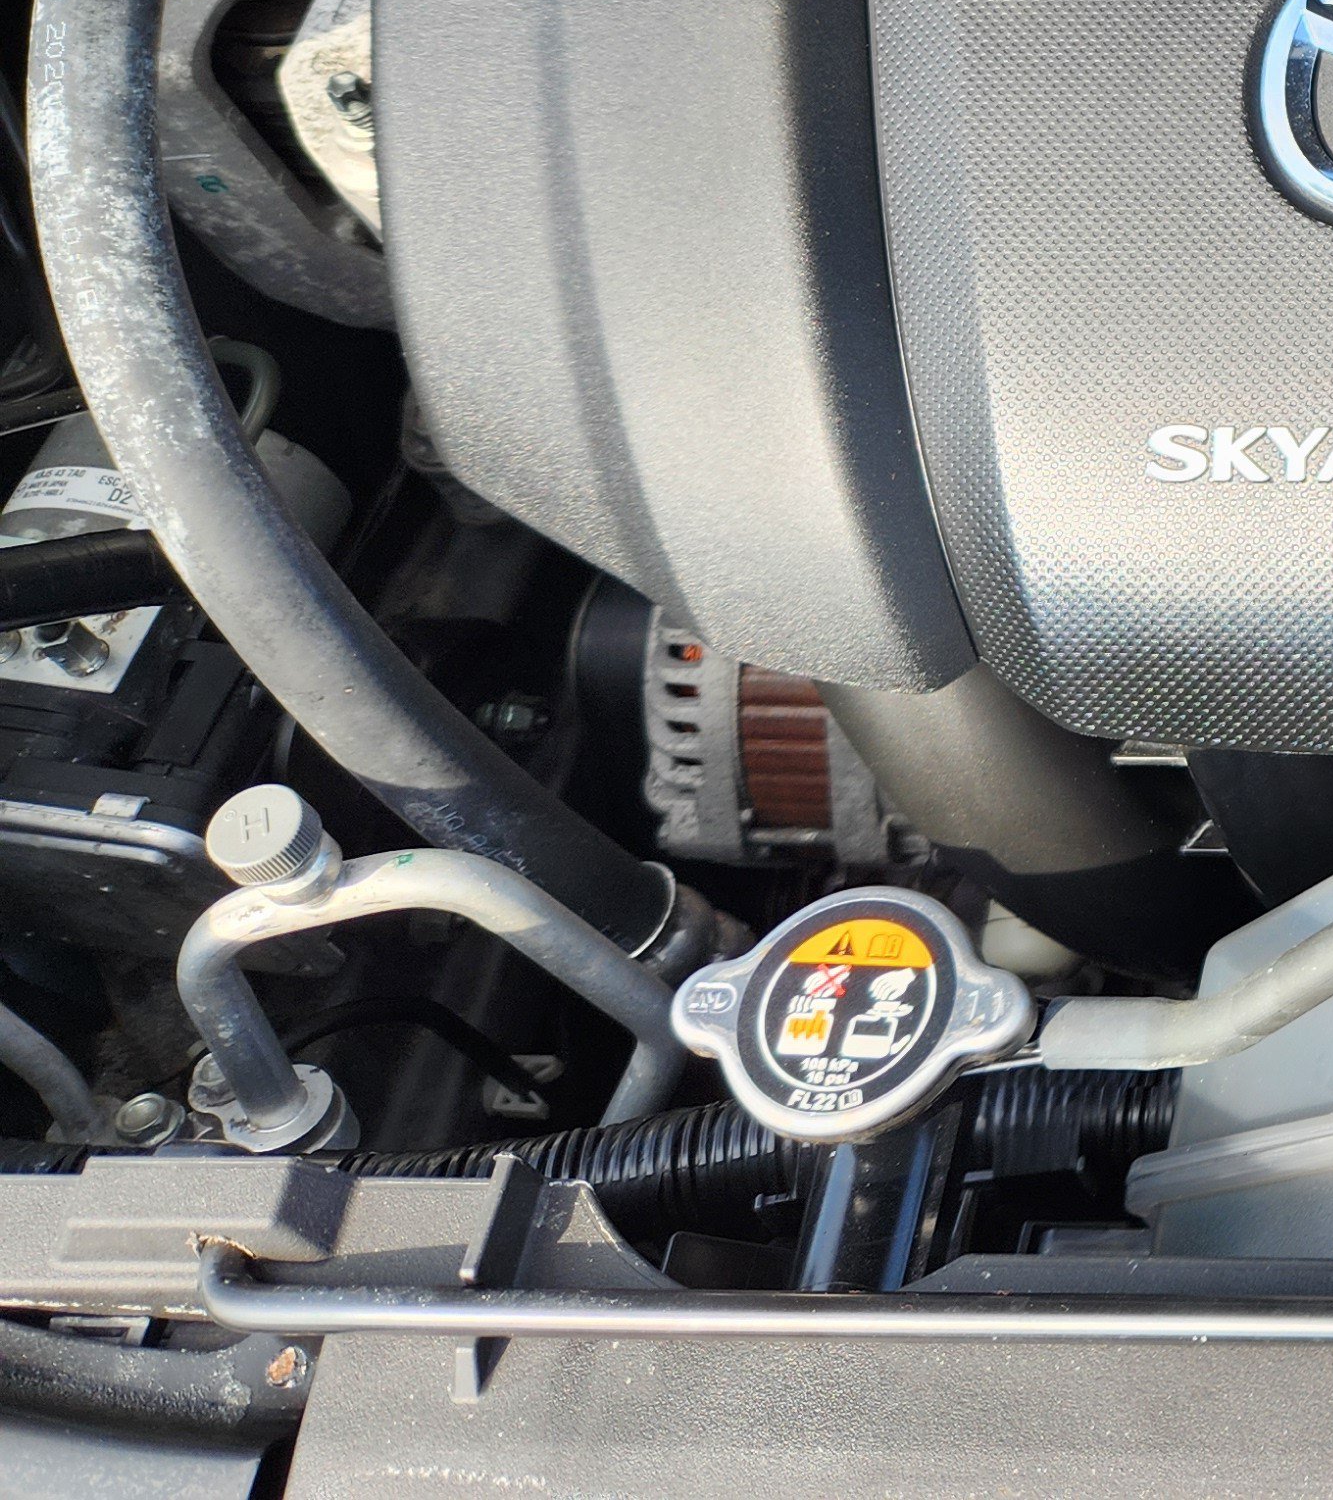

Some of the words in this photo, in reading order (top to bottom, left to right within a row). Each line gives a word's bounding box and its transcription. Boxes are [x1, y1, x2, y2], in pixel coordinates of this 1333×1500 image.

[97, 474, 121, 487] ESC
[824, 1072, 851, 1087] psi
[787, 1088, 838, 1111] FL22
